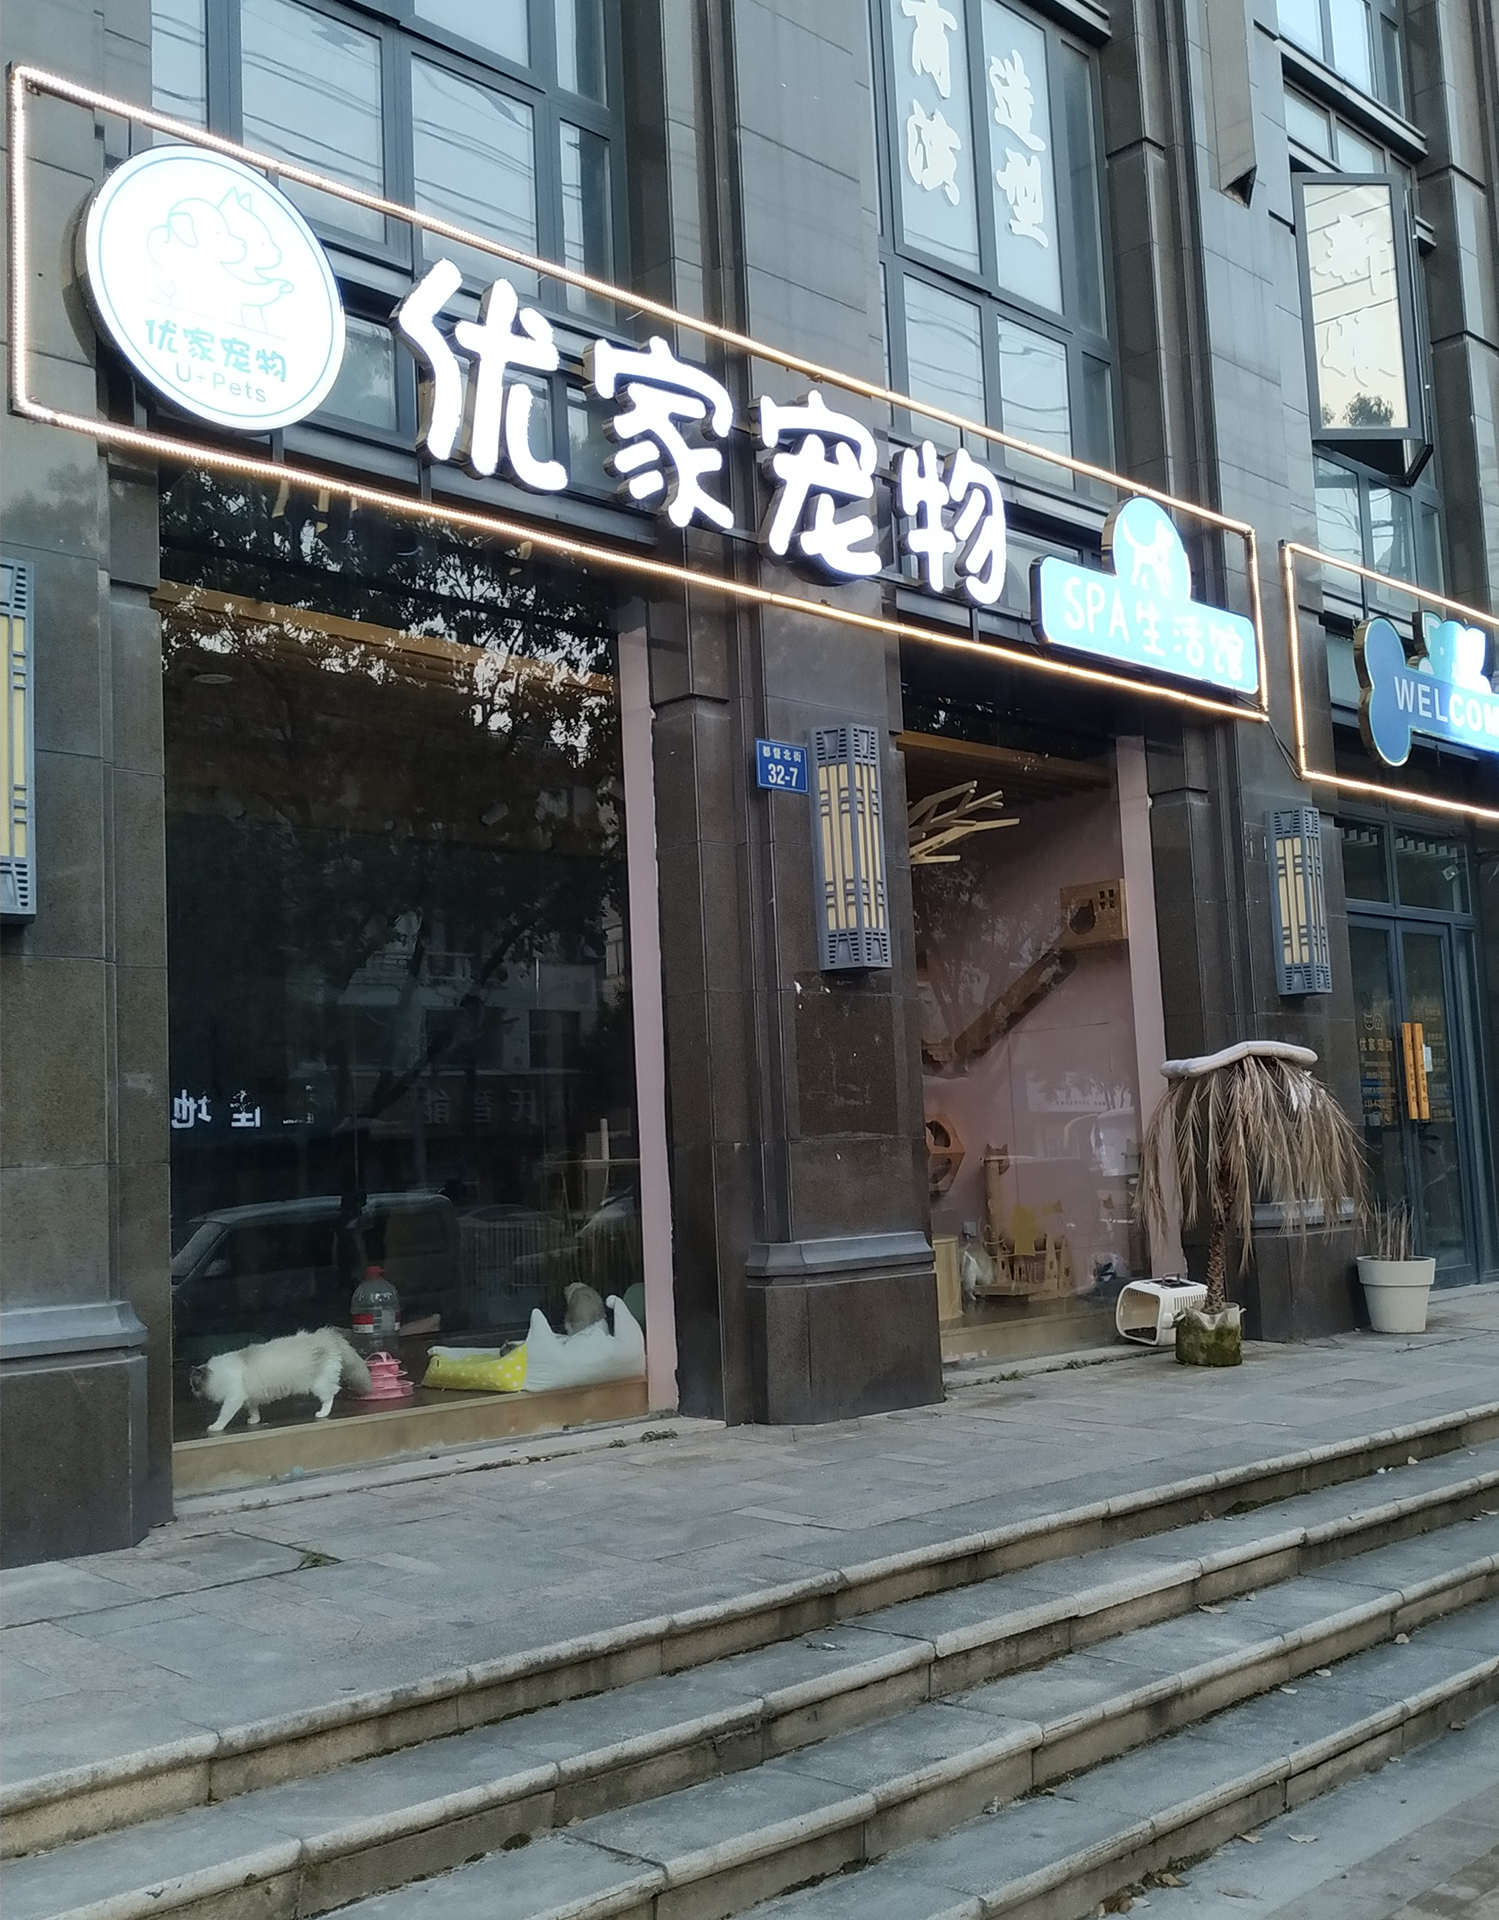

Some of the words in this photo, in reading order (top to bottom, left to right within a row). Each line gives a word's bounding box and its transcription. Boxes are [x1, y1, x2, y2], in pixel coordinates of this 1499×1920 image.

[989, 49, 1049, 248] 造型
[145, 318, 287, 383] 优家宠物
[398, 256, 1007, 606] 优家宠物
[768, 763, 798, 787] 32-7
